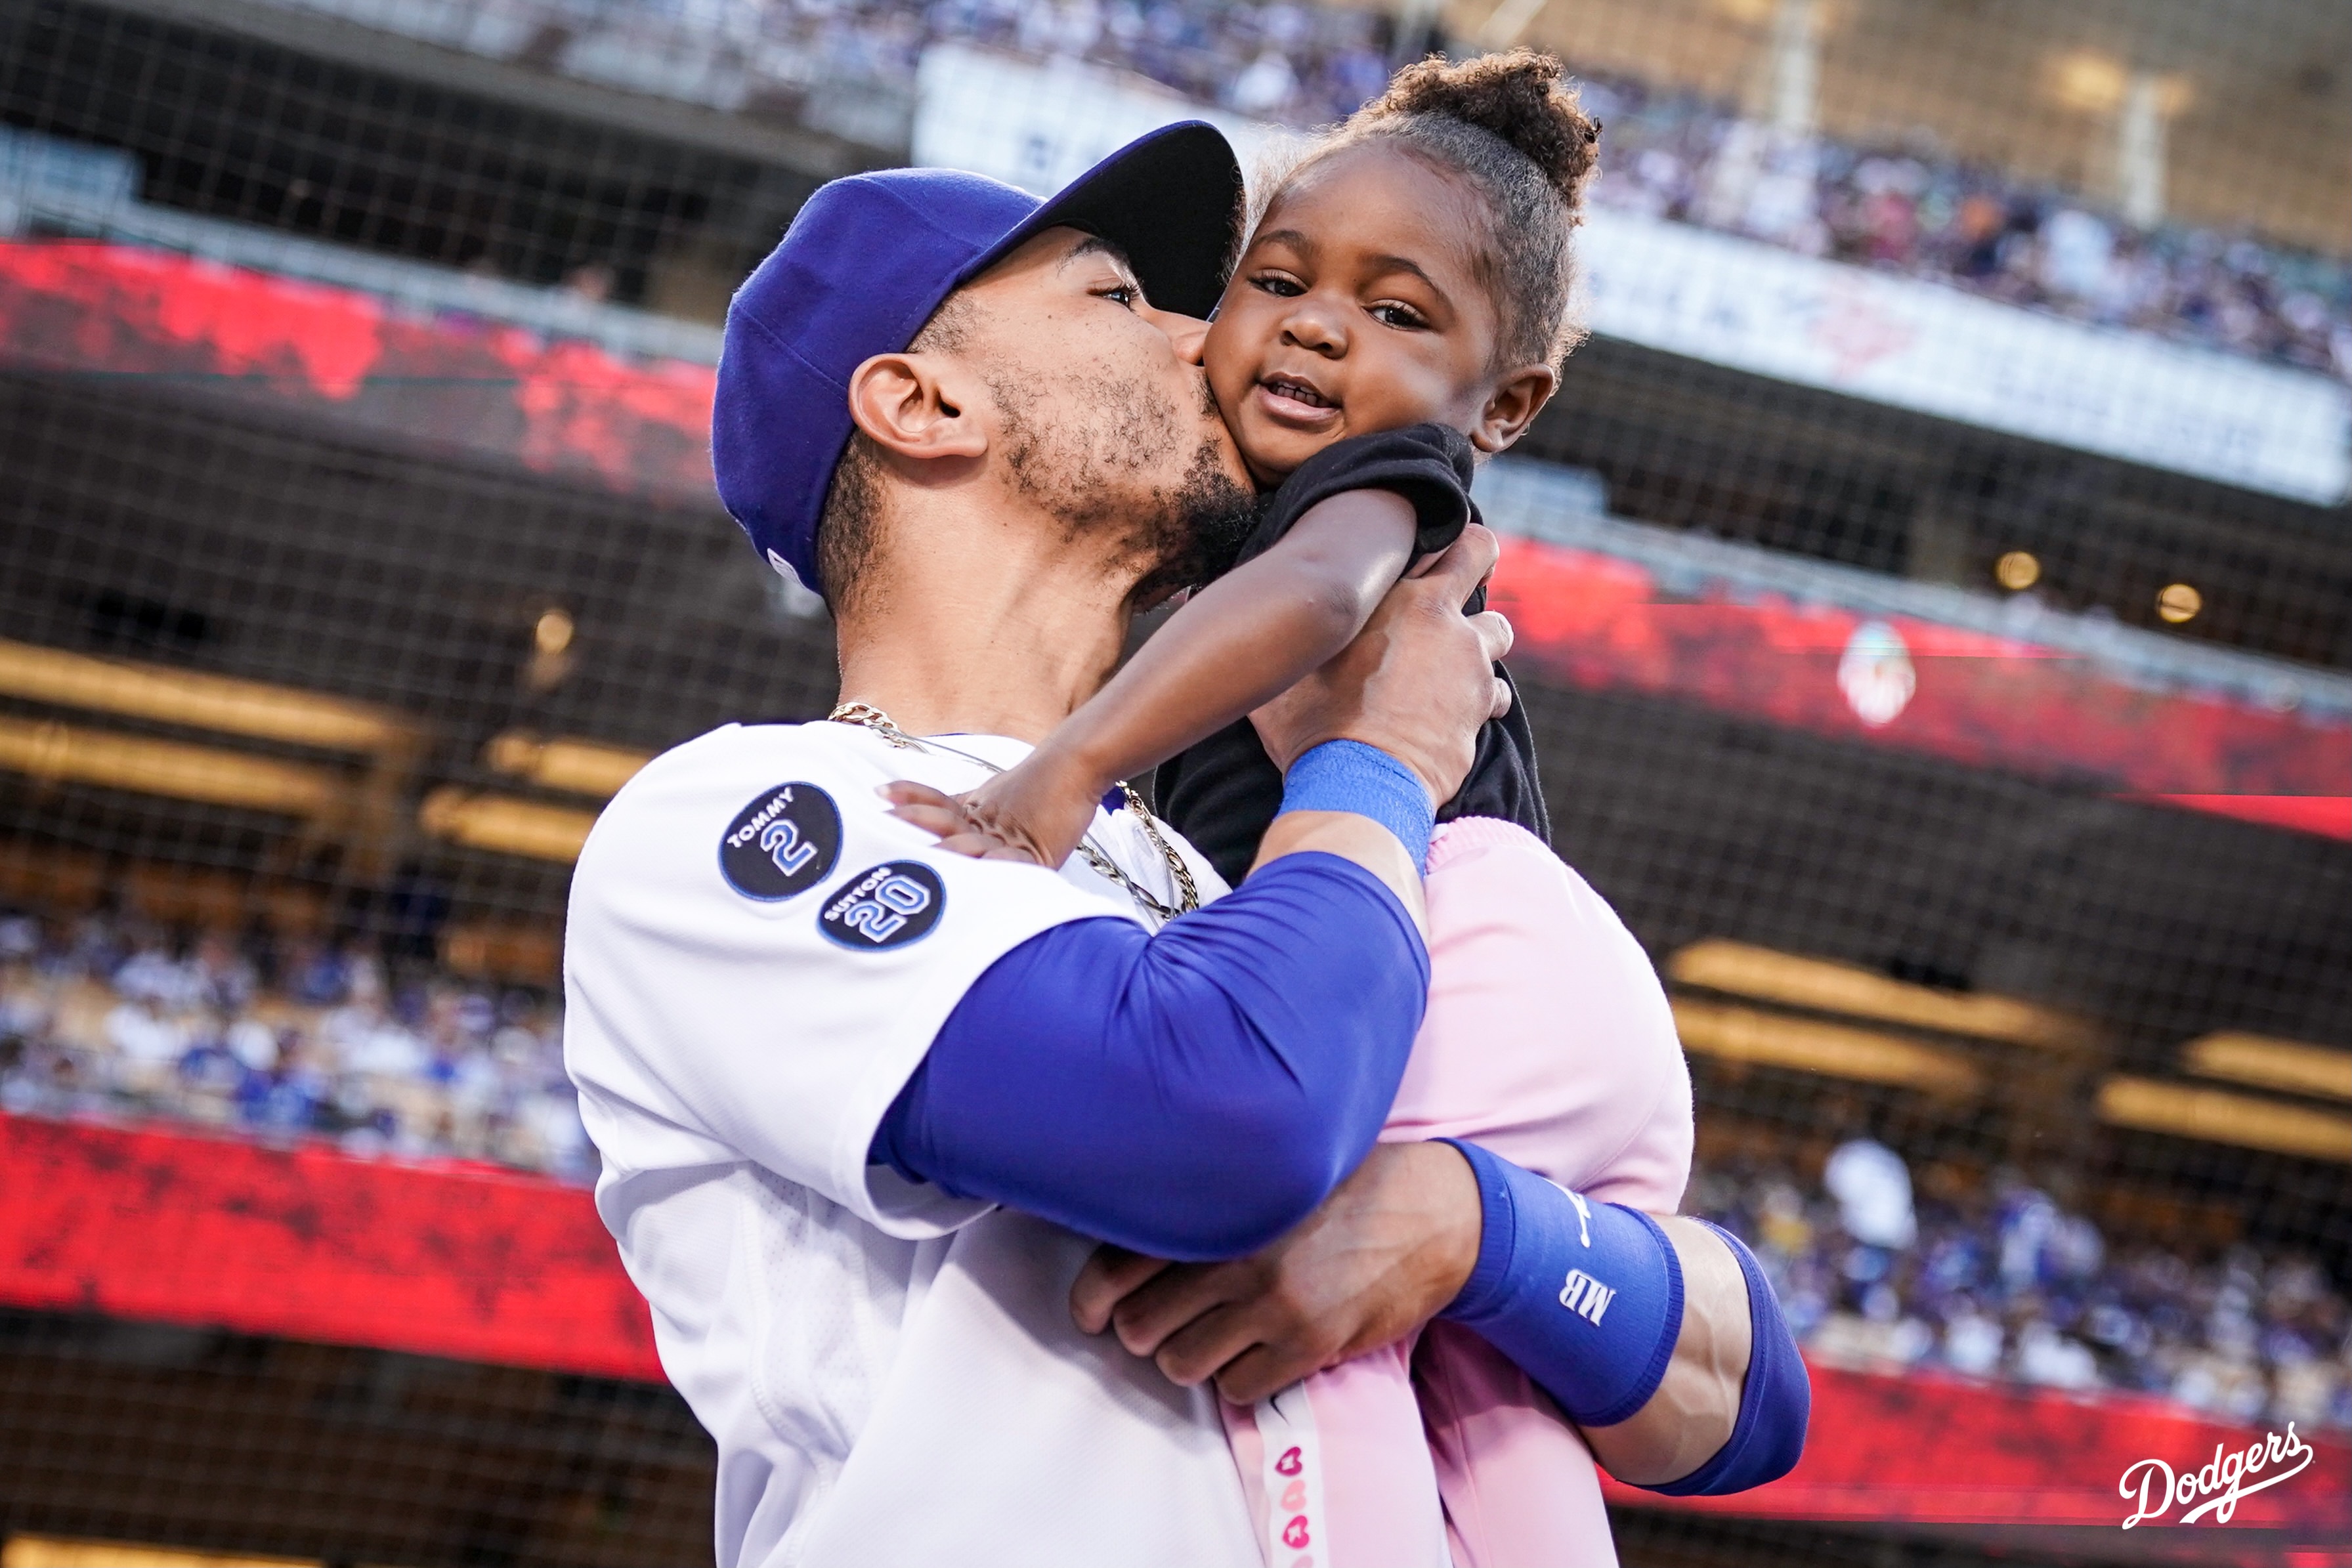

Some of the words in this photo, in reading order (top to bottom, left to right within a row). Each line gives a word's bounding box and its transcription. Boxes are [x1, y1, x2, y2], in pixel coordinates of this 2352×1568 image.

[727, 787, 794, 848] TOMMY
[760, 819, 818, 877] 2
[824, 867, 892, 922] SUTTON
[844, 874, 931, 943] 20
[1558, 1268, 1616, 1327] MB
